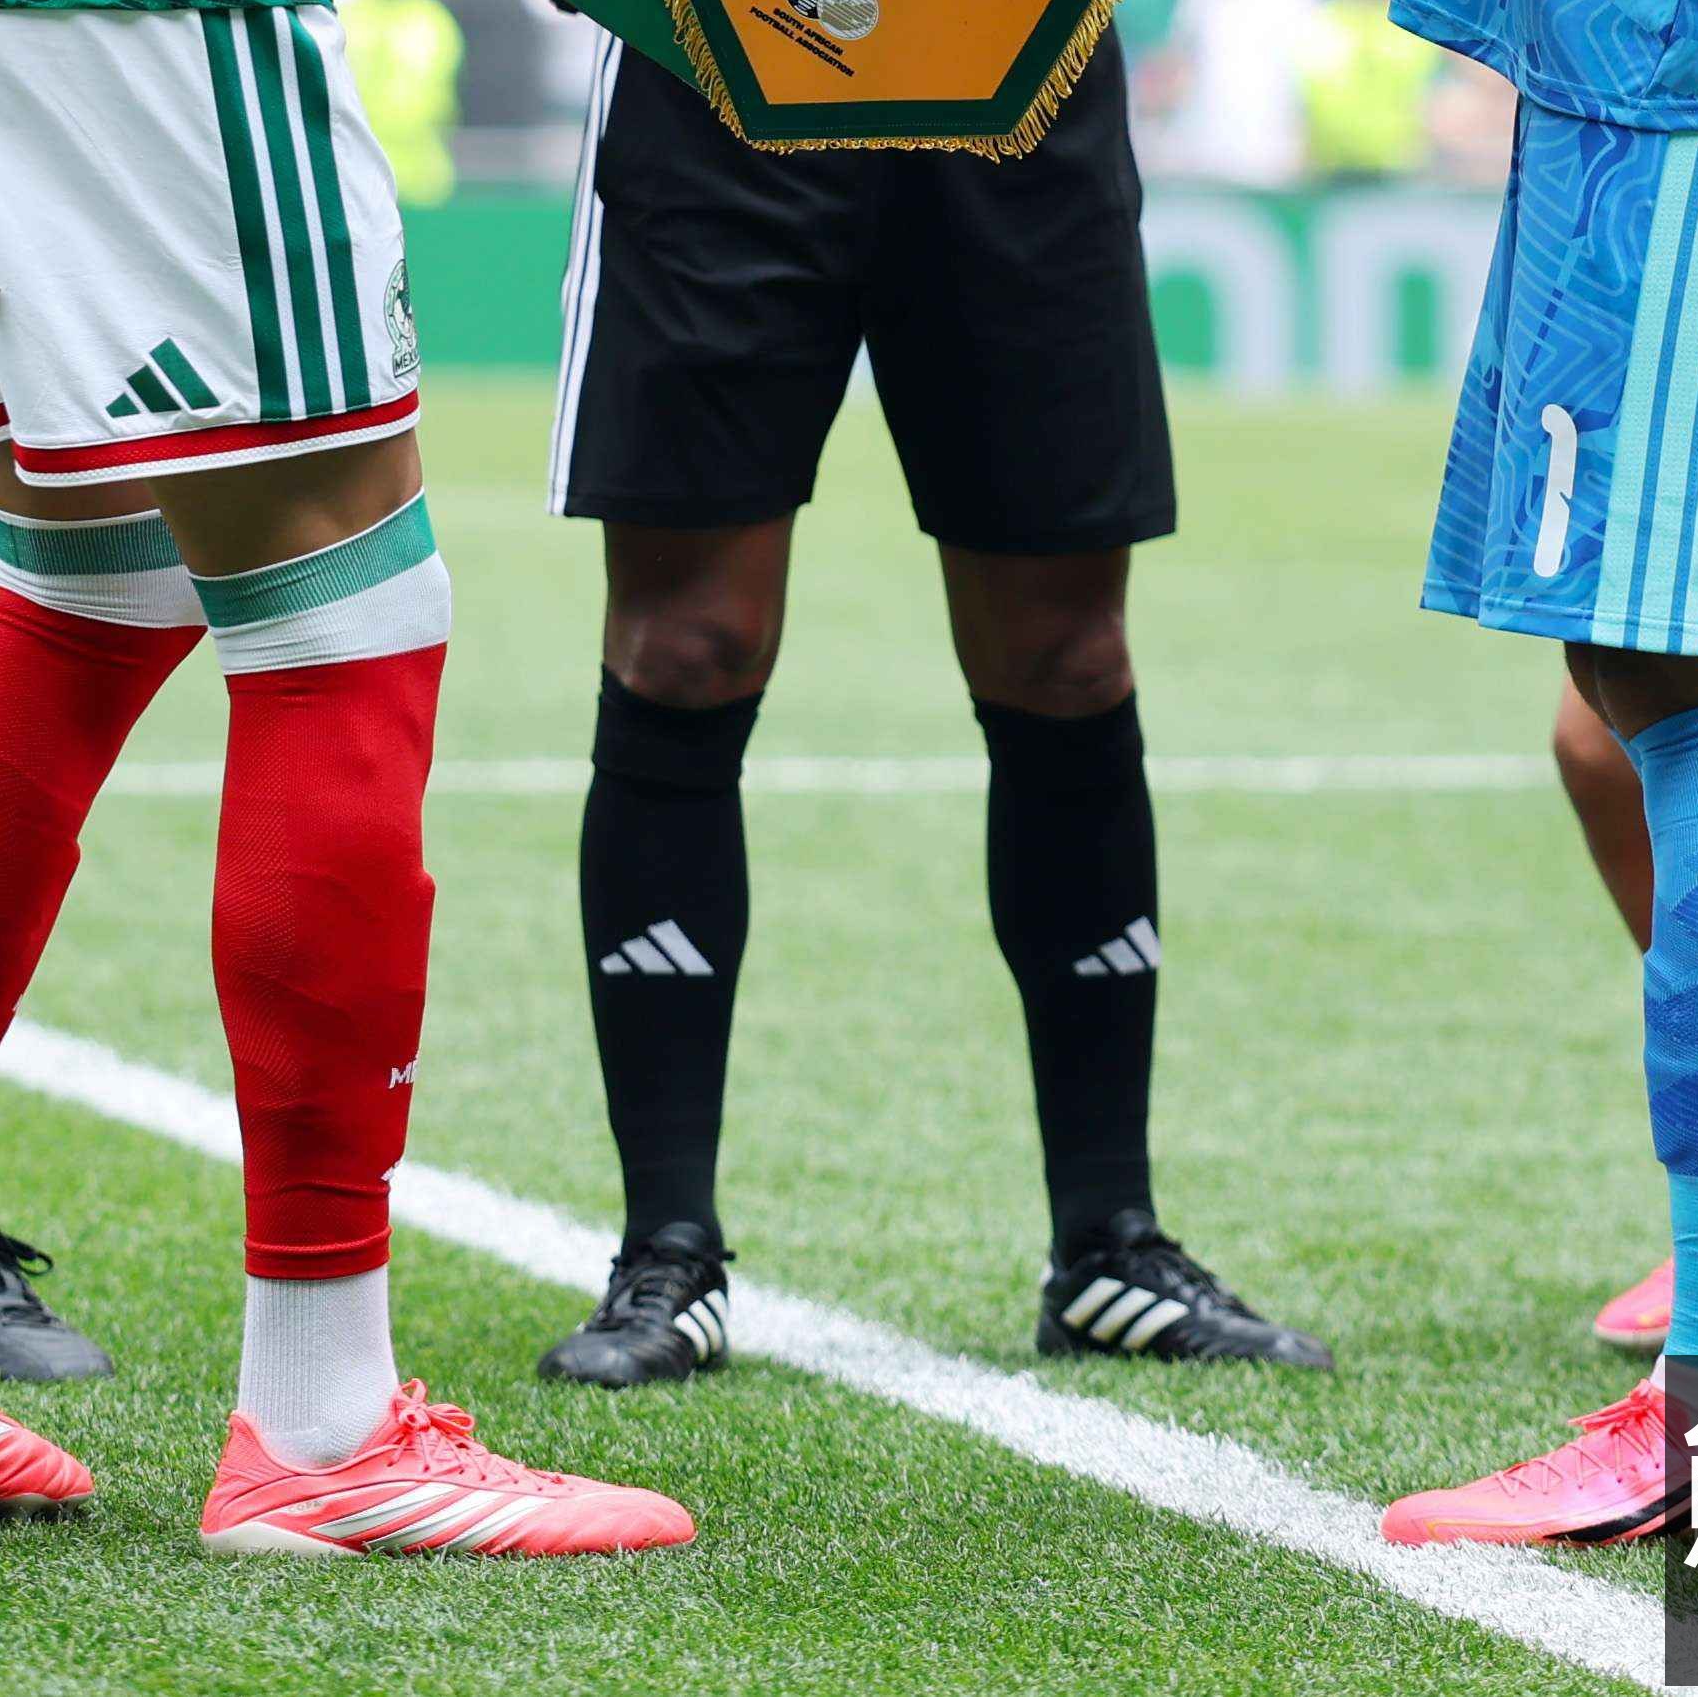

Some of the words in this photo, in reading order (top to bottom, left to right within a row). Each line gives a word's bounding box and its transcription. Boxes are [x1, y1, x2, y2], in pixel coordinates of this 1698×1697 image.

[749, 6, 795, 40] FOOTBALL
[795, 36, 855, 78] ASSOCIATION
[773, 7, 805, 31] SOUTH
[804, 27, 844, 56] AFRICAN
[1533, 404, 1577, 577] 1
